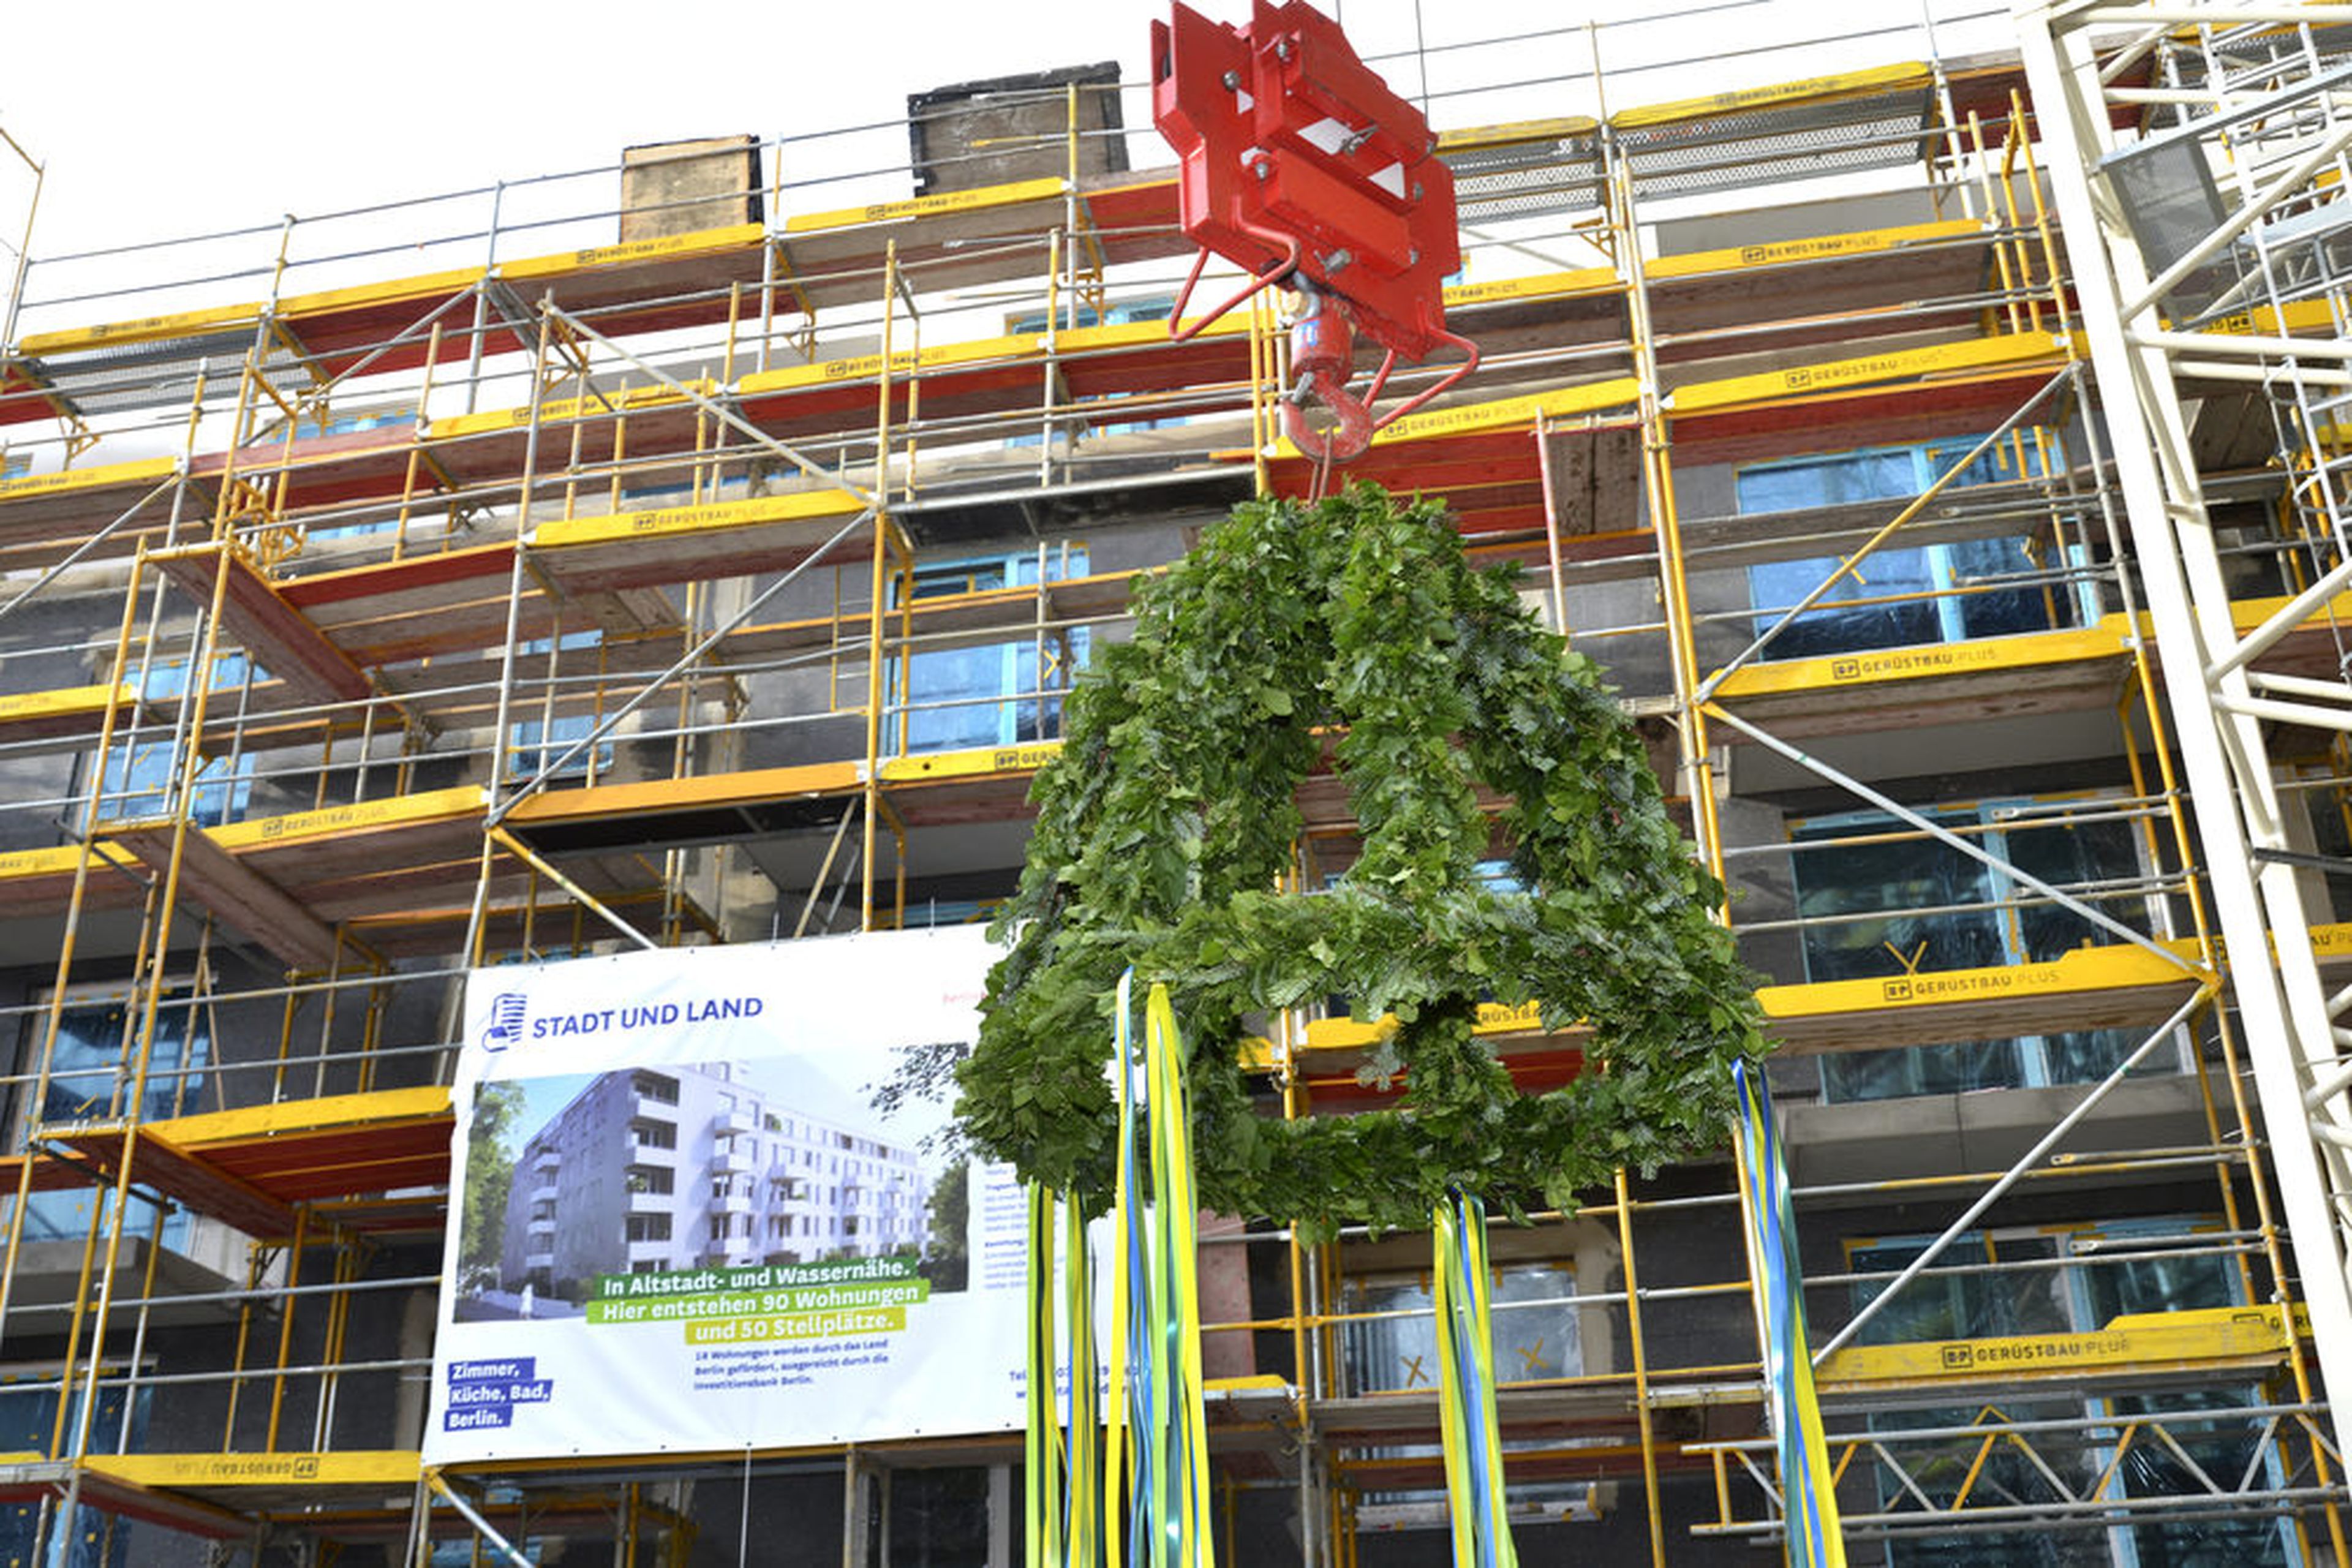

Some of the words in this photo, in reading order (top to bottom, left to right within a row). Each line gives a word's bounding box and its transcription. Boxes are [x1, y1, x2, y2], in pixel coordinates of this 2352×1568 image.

[533, 1011, 614, 1039] STADT
[621, 1004, 679, 1028] UND
[687, 997, 763, 1022] LAND
[605, 1278, 624, 1296] In
[630, 1268, 725, 1294] Altstadt-
[731, 1268, 771, 1287] und
[776, 1261, 911, 1284] Wassernähe.
[603, 1301, 646, 1320] Hier
[652, 1295, 756, 1316] entstehen
[763, 1294, 789, 1310] 90
[795, 1285, 919, 1307] Wohnungen
[696, 1322, 735, 1341] und
[741, 1320, 767, 1338] 50
[774, 1314, 894, 1337] Stellplätze.
[1977, 1343, 2081, 1362] GERÜSTBAU
[452, 1363, 520, 1380] Zimmer,
[450, 1385, 507, 1404] Küche,
[510, 1382, 549, 1400] Bad,
[449, 1409, 503, 1428] Berlin.
